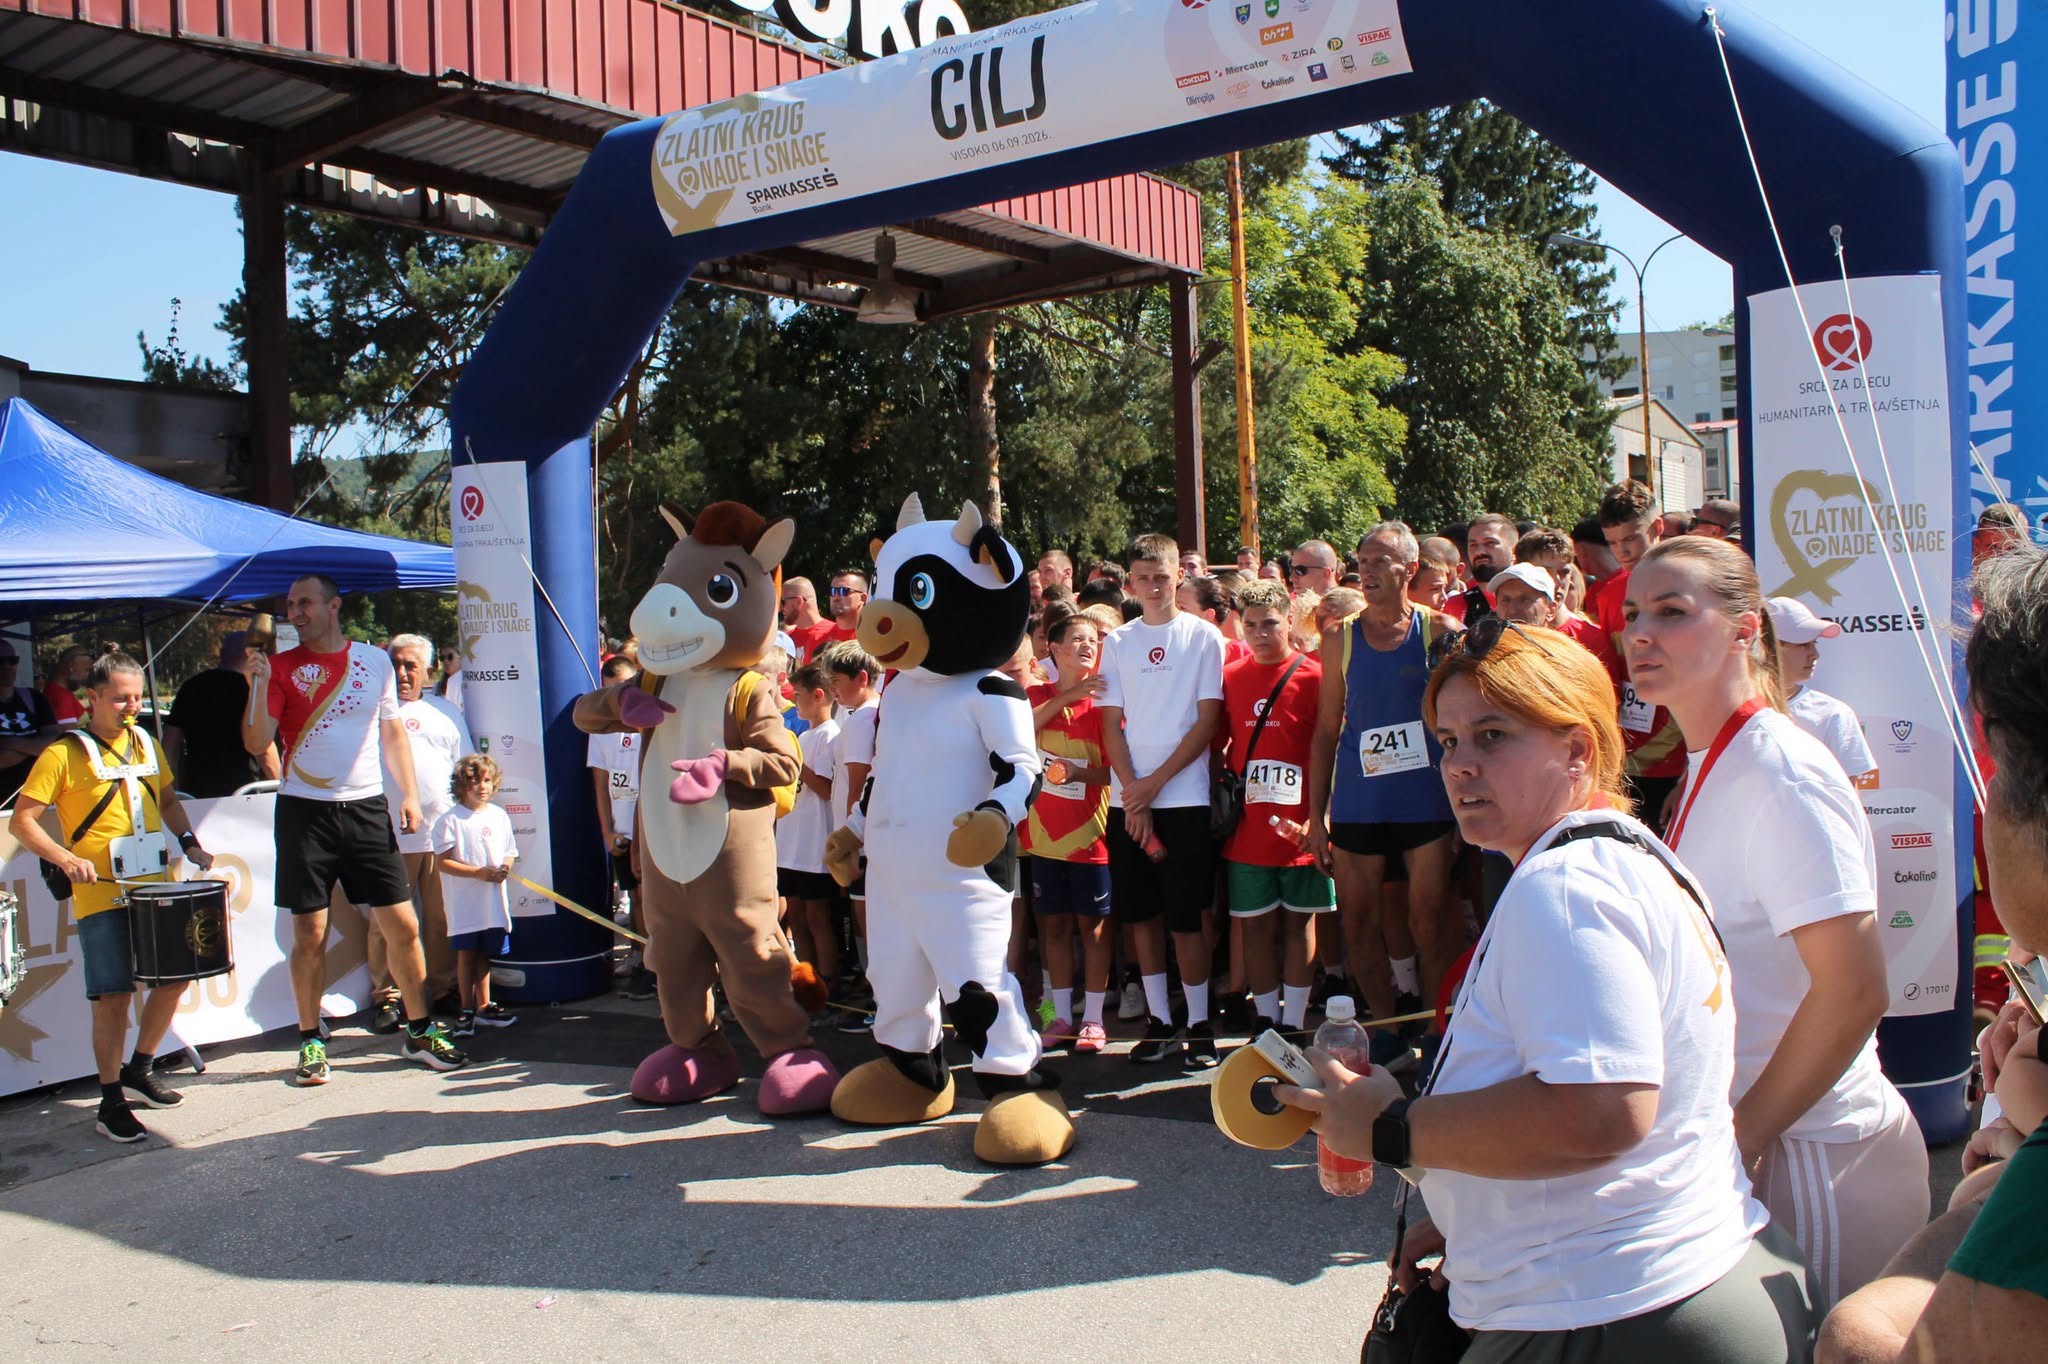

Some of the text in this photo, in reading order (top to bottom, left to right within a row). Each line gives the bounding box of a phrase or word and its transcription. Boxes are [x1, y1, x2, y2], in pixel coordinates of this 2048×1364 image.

[1358, 30, 1390, 42] VISPAK
[1225, 59, 1269, 75] Mercator
[1292, 48, 1316, 59] ZIRA
[931, 35, 1046, 140] CILJ
[661, 101, 806, 167] ZLATNI KRUG
[951, 130, 1052, 160] VISOKO 06.09.2026.
[700, 132, 830, 191] NADE I SNAGE
[746, 176, 824, 204] SPARKASSE
[752, 204, 772, 214] Bank
[1956, 60, 2018, 526] ARKASSE
[1799, 381, 1826, 394] SRCE
[1833, 379, 1849, 391] ZA
[1791, 503, 1927, 535] ZLATNI KRUG
[1828, 533, 1876, 556] NADE
[1893, 531, 1945, 553] SNAGE
[461, 602, 518, 620] LATNI KRUG
[497, 619, 531, 633] SNAGE
[1820, 614, 1903, 633] KASSE
[1370, 728, 1409, 754] 241
[612, 772, 629, 788] 52
[1251, 764, 1297, 786] 4118
[1892, 836, 1932, 846] VISPAK
[1925, 984, 1950, 995] 17010
